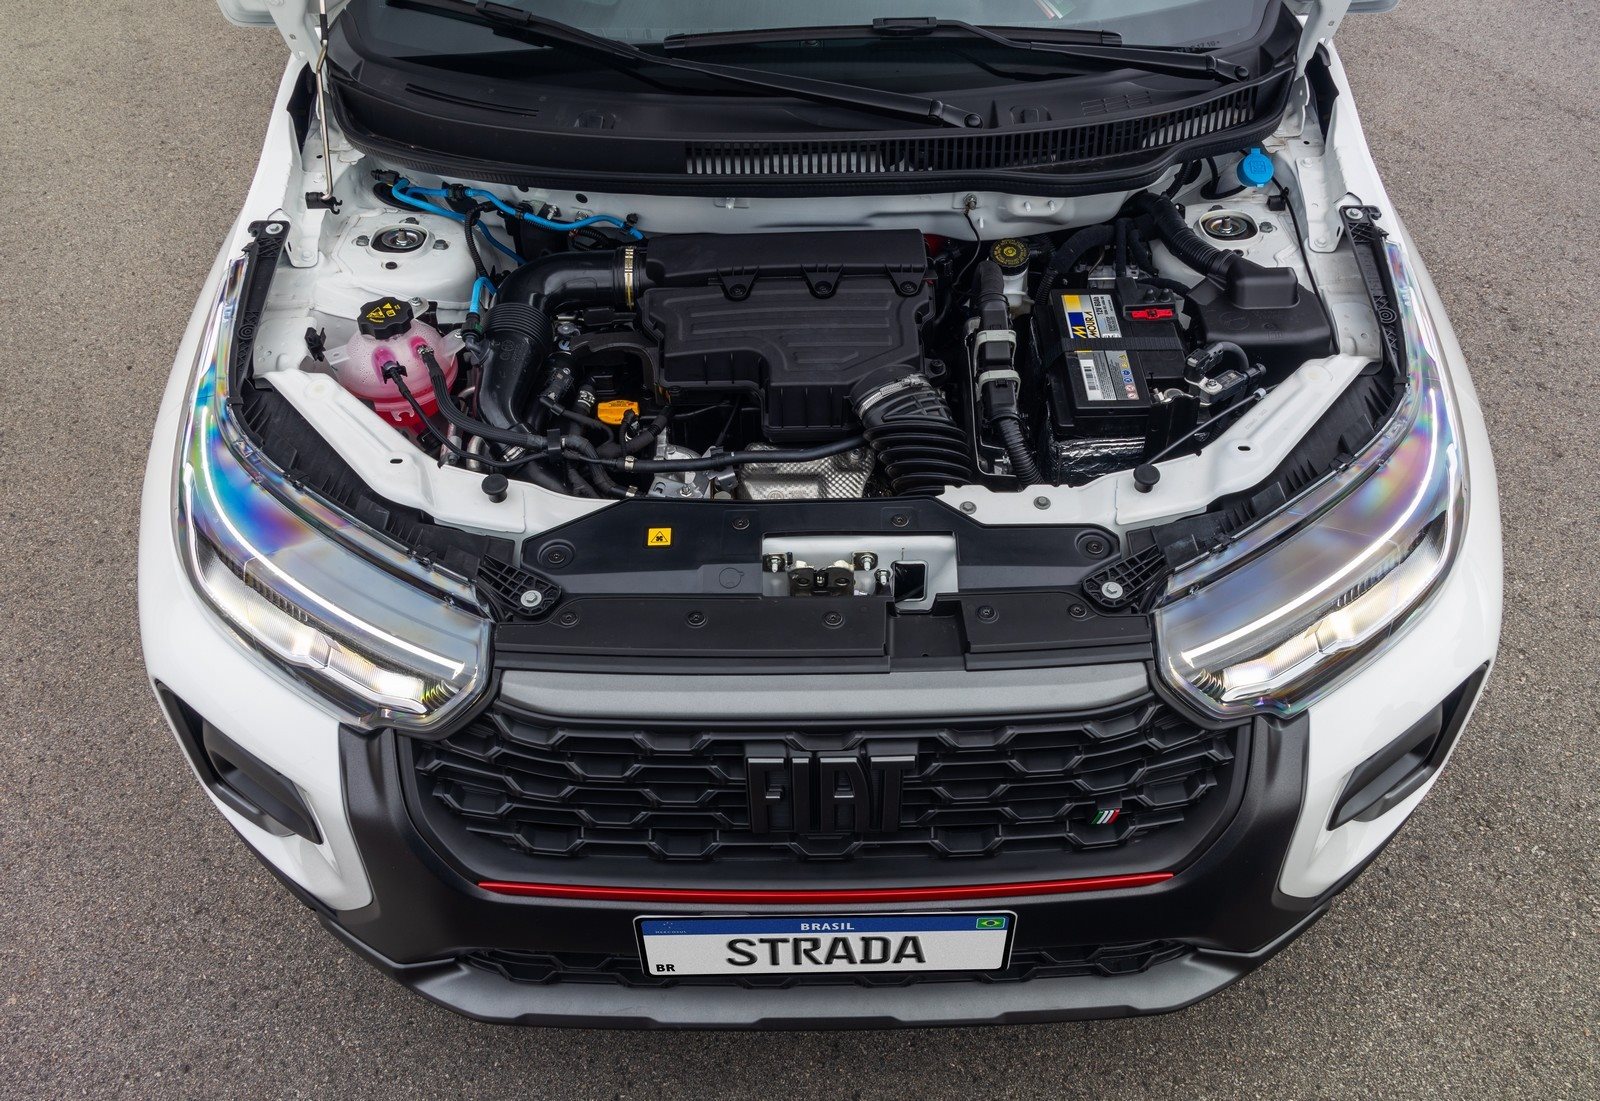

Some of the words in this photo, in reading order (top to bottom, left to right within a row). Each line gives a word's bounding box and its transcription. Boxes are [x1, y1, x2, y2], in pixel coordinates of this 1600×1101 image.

[1084, 311, 1100, 339] MOURA
[747, 754, 916, 834] FIAT
[800, 922, 855, 931] BRASIL
[726, 935, 926, 967] STRADA
[656, 964, 676, 972] BR
